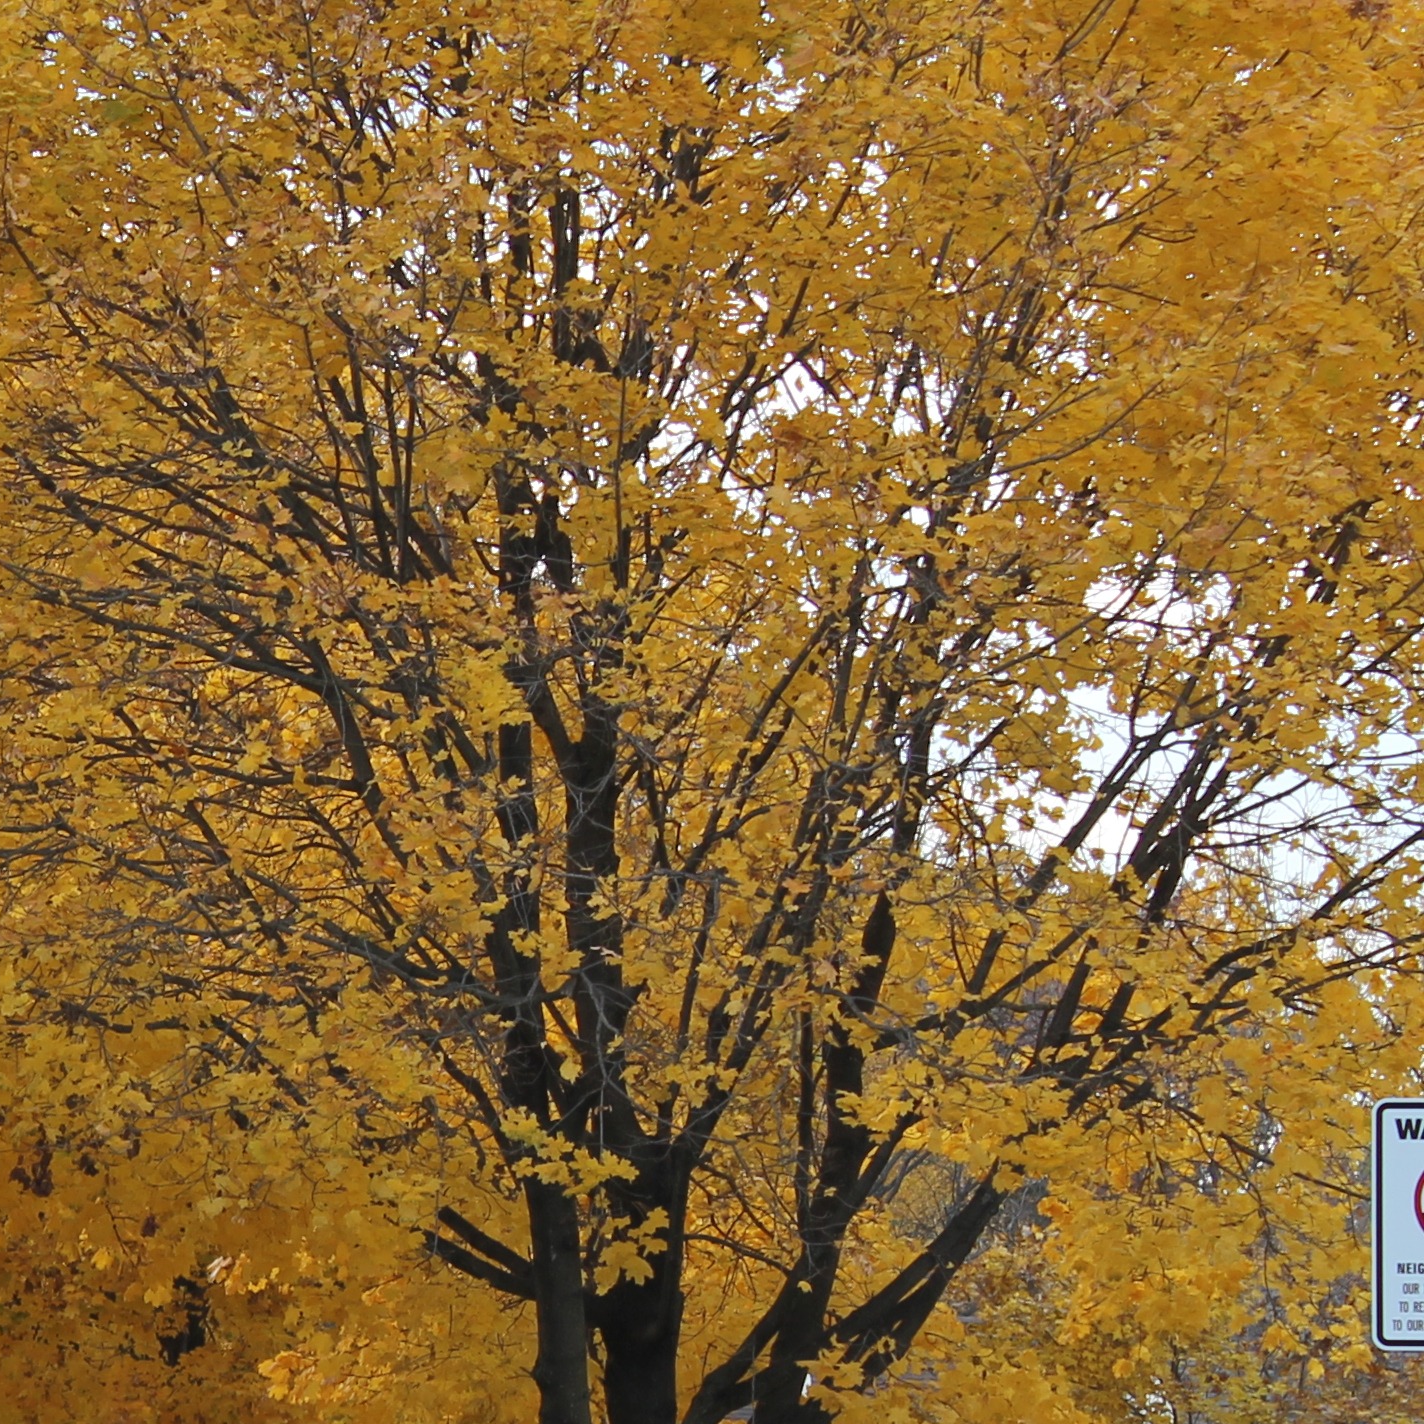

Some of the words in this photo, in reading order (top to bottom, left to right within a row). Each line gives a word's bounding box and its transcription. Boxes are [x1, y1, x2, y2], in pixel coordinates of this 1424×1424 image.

[1402, 1283, 1420, 1294] OUR
[1399, 1301, 1409, 1313] TO
[1393, 1319, 1403, 1331] TO
